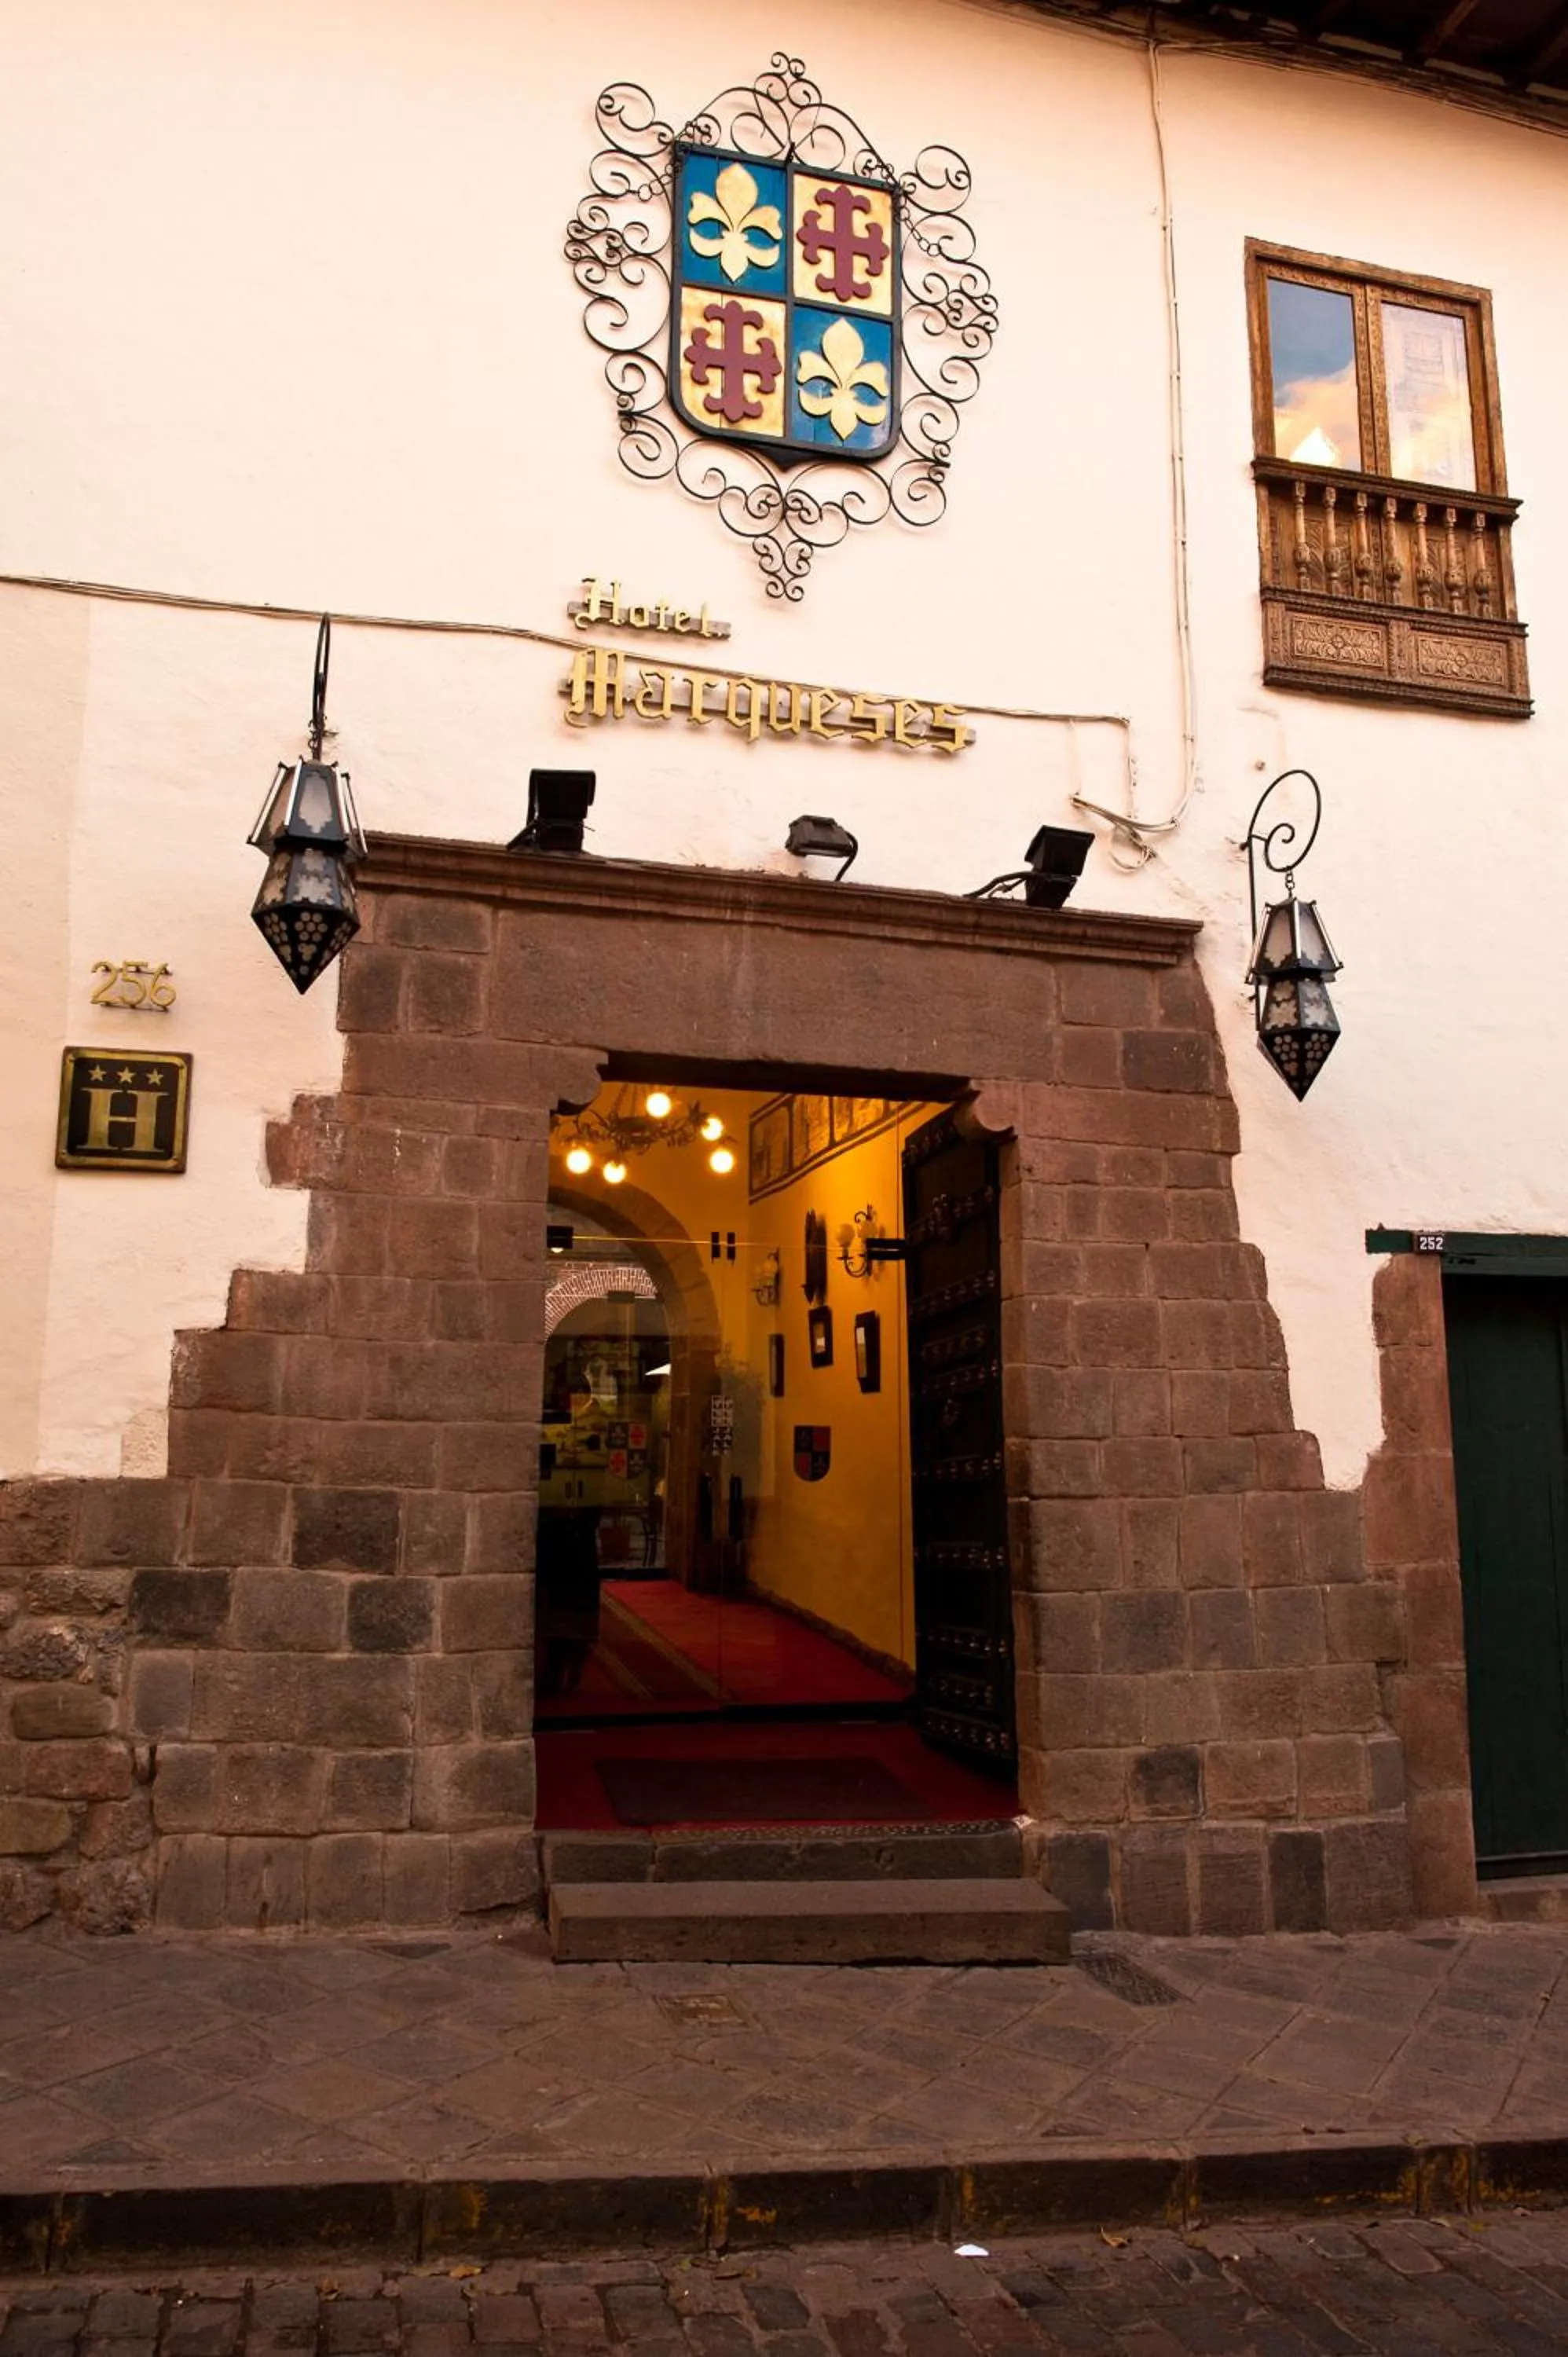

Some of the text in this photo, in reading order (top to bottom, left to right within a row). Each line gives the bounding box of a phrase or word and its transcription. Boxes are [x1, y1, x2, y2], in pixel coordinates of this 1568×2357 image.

[573, 577, 713, 638] Hotel
[564, 647, 969, 752] Marqueses
[90, 961, 177, 1006] 256
[75, 1087, 170, 1152] H
[1420, 1237, 1443, 1250] 252
